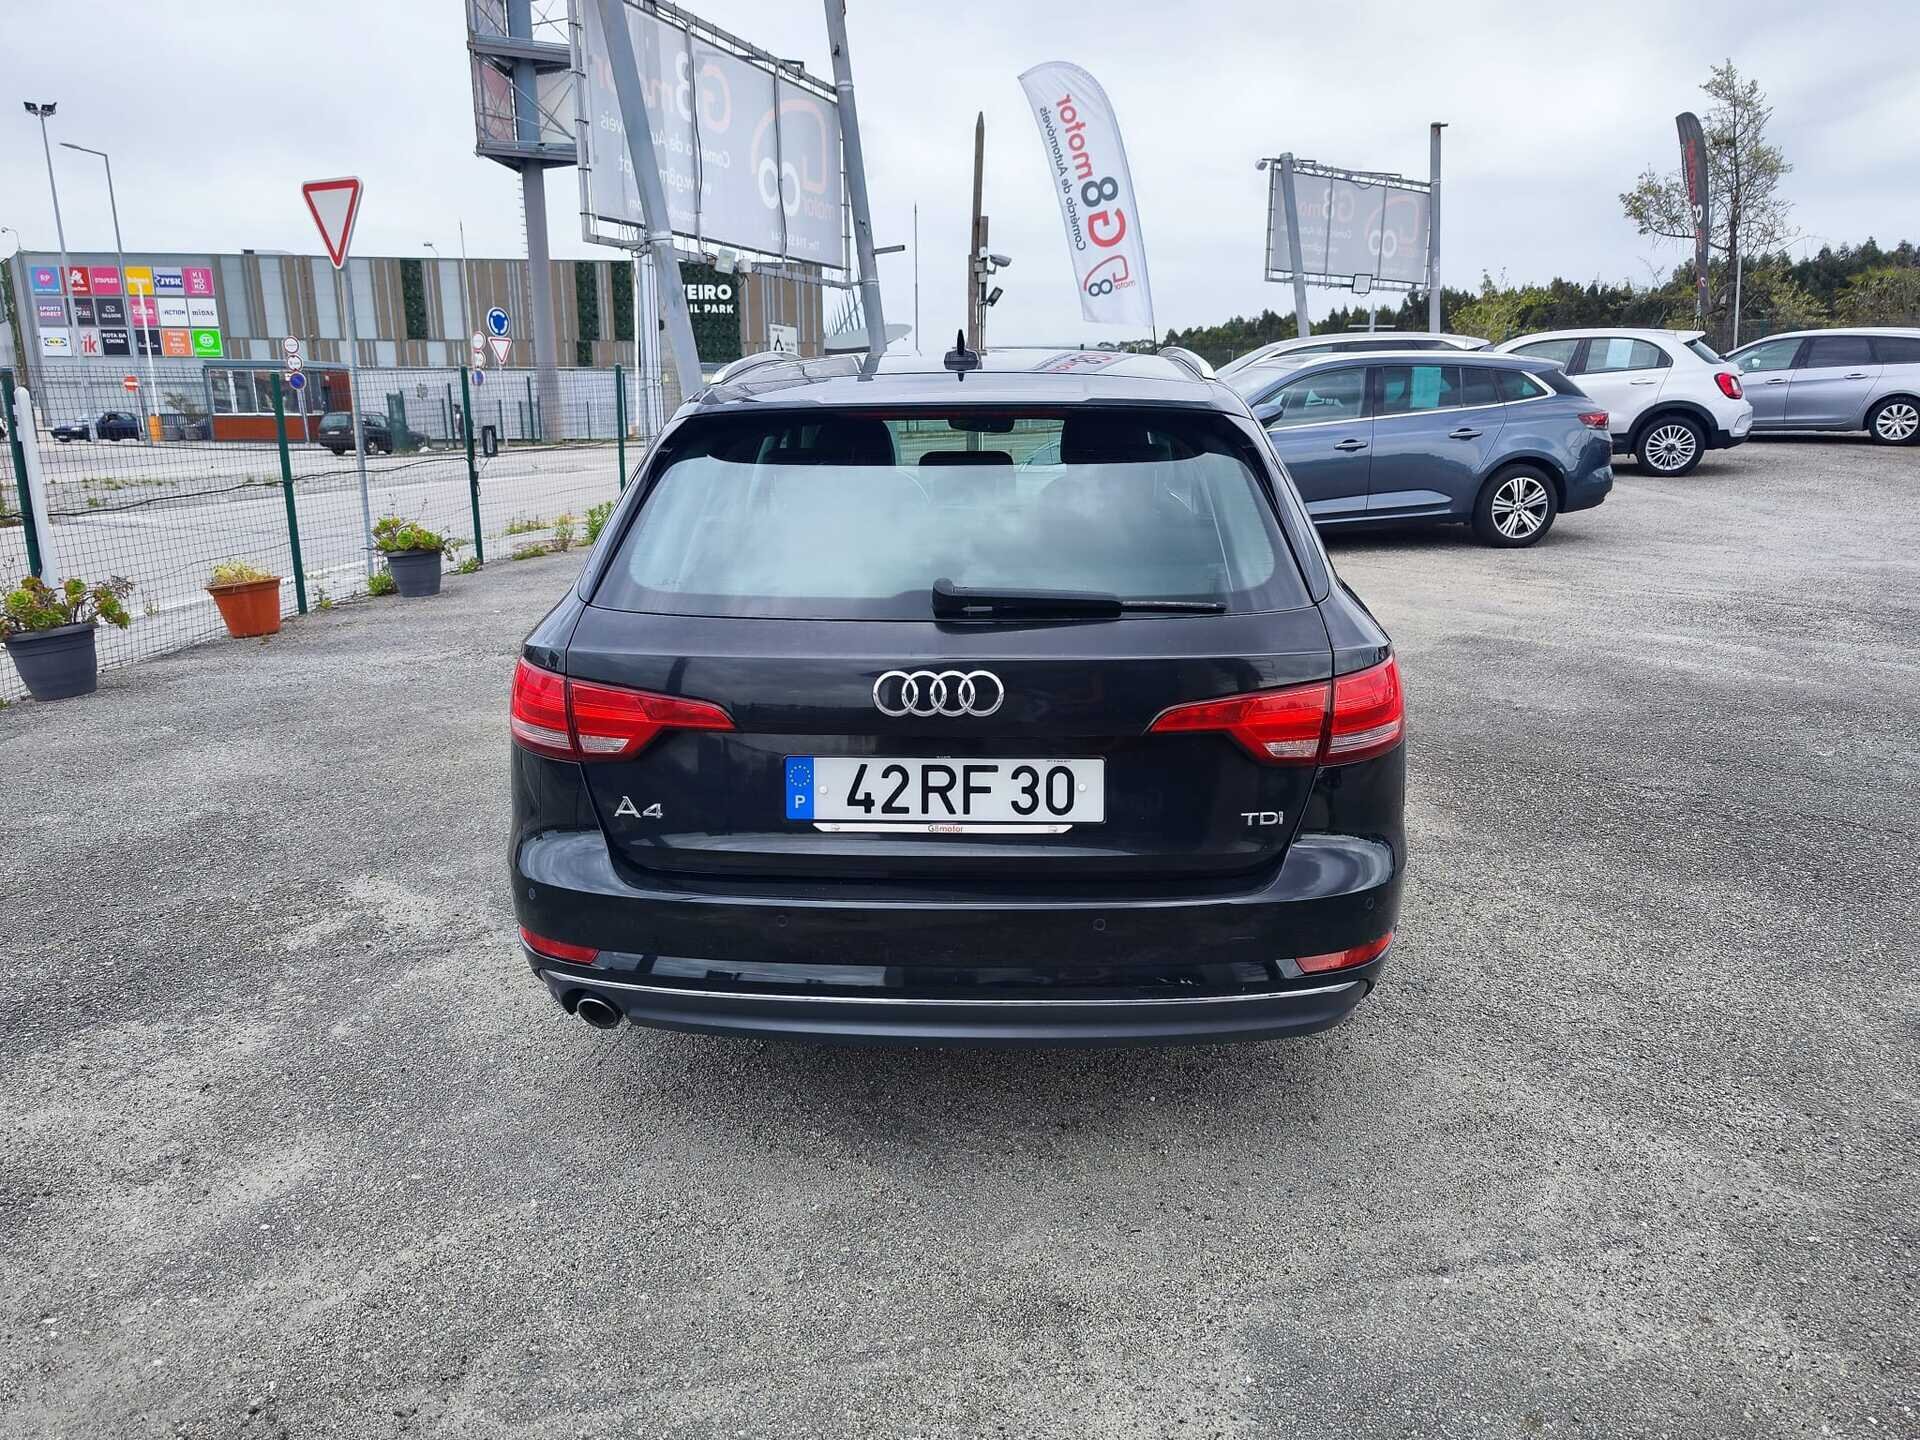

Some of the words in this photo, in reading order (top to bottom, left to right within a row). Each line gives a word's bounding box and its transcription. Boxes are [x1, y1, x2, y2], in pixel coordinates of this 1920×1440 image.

[160, 277, 182, 286] JYSK
[704, 304, 734, 314] PARK
[614, 795, 664, 819] A4
[795, 795, 806, 809] P
[1240, 810, 1284, 826] TDI
